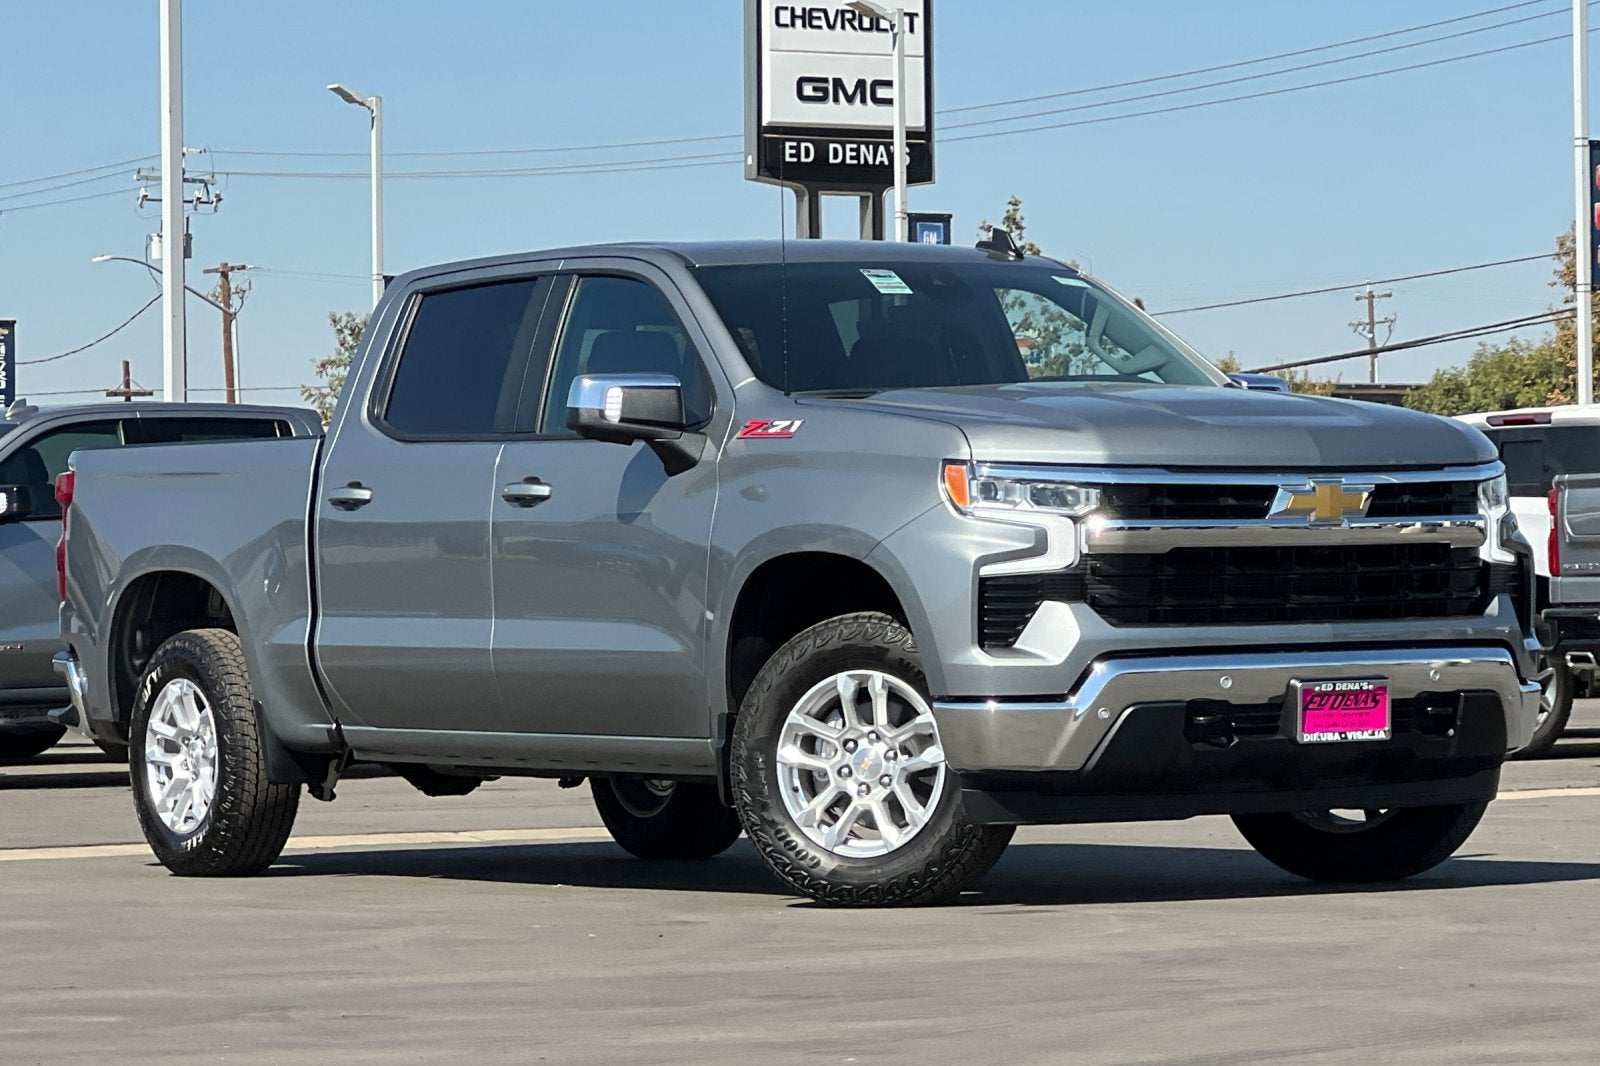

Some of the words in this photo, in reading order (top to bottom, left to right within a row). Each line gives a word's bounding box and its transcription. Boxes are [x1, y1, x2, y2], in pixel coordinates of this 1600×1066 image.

[775, 6, 919, 34] CHEVROLT
[796, 75, 894, 106] GMC
[785, 142, 815, 163] ED
[923, 230, 937, 245] GM
[737, 419, 805, 438] Z71
[1321, 683, 1334, 691] ED
[1335, 682, 1369, 691] DENA'S
